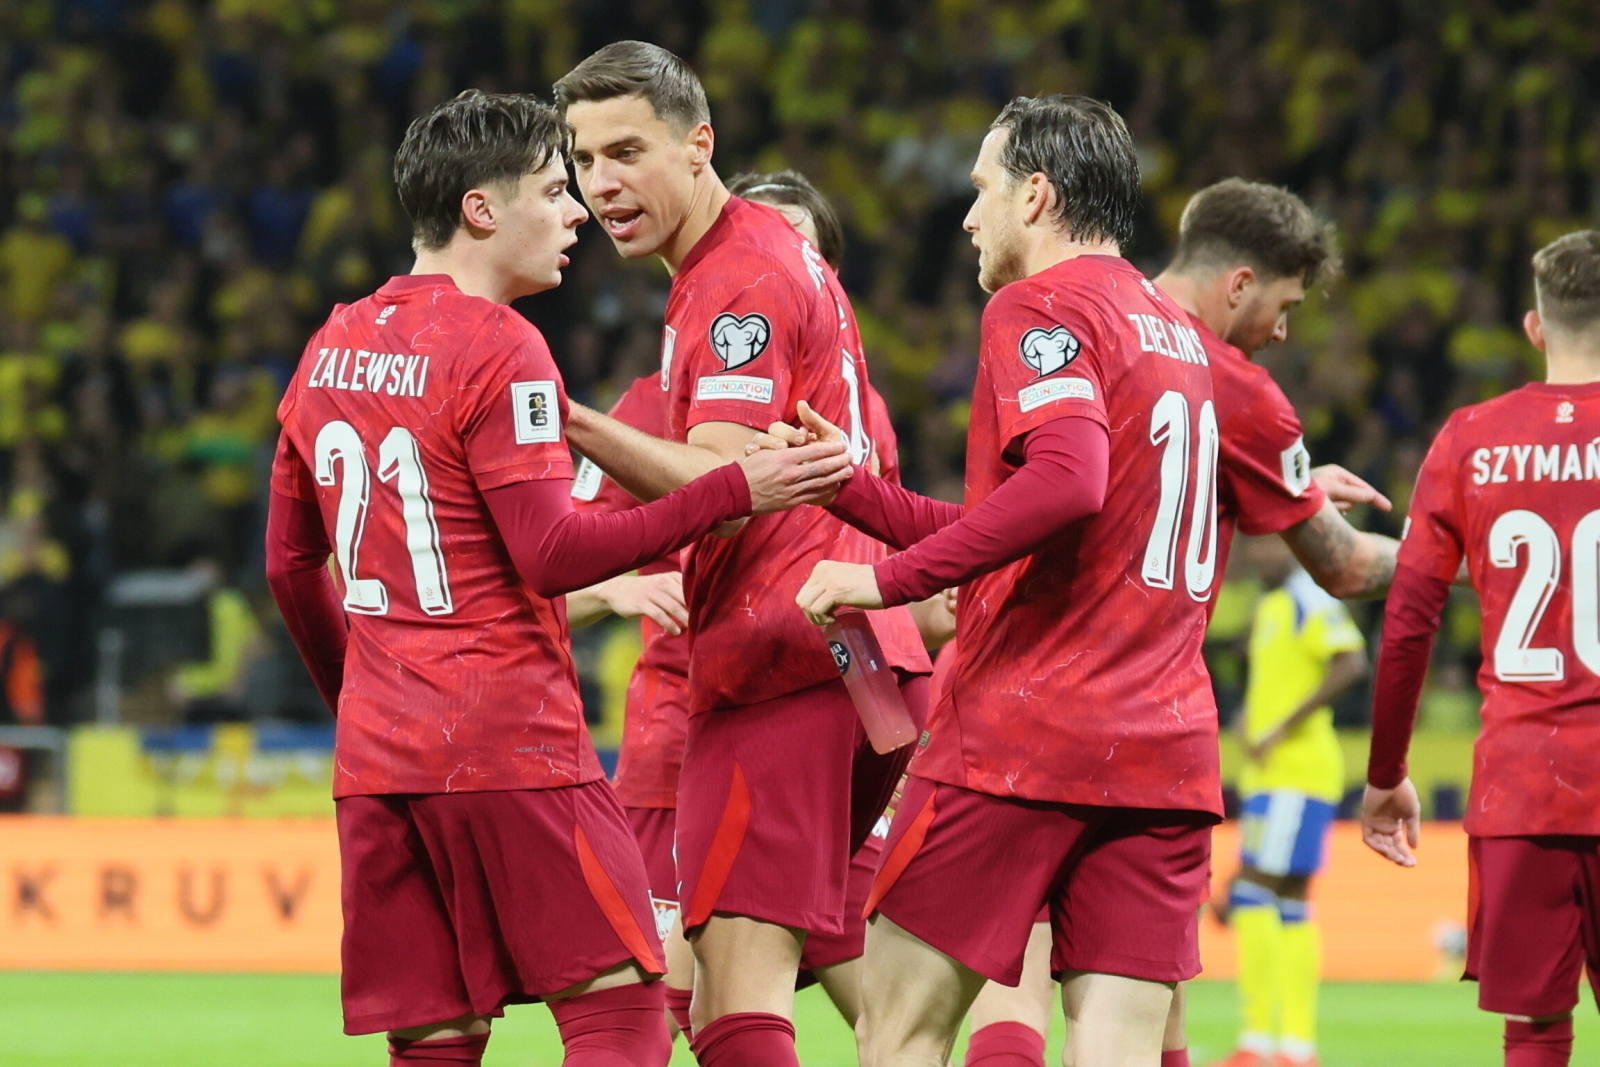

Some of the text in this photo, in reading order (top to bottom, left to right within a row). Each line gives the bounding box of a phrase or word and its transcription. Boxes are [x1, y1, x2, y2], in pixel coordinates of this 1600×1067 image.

[307, 347, 430, 398] ZALEWSKI
[700, 382, 771, 395] FOUNDATION
[1022, 384, 1092, 405] FOUNDATION
[1473, 436, 1600, 486] SZYMAŃ
[314, 420, 454, 616] 21
[1140, 390, 1219, 603] 10
[12, 863, 314, 928] KRUV
